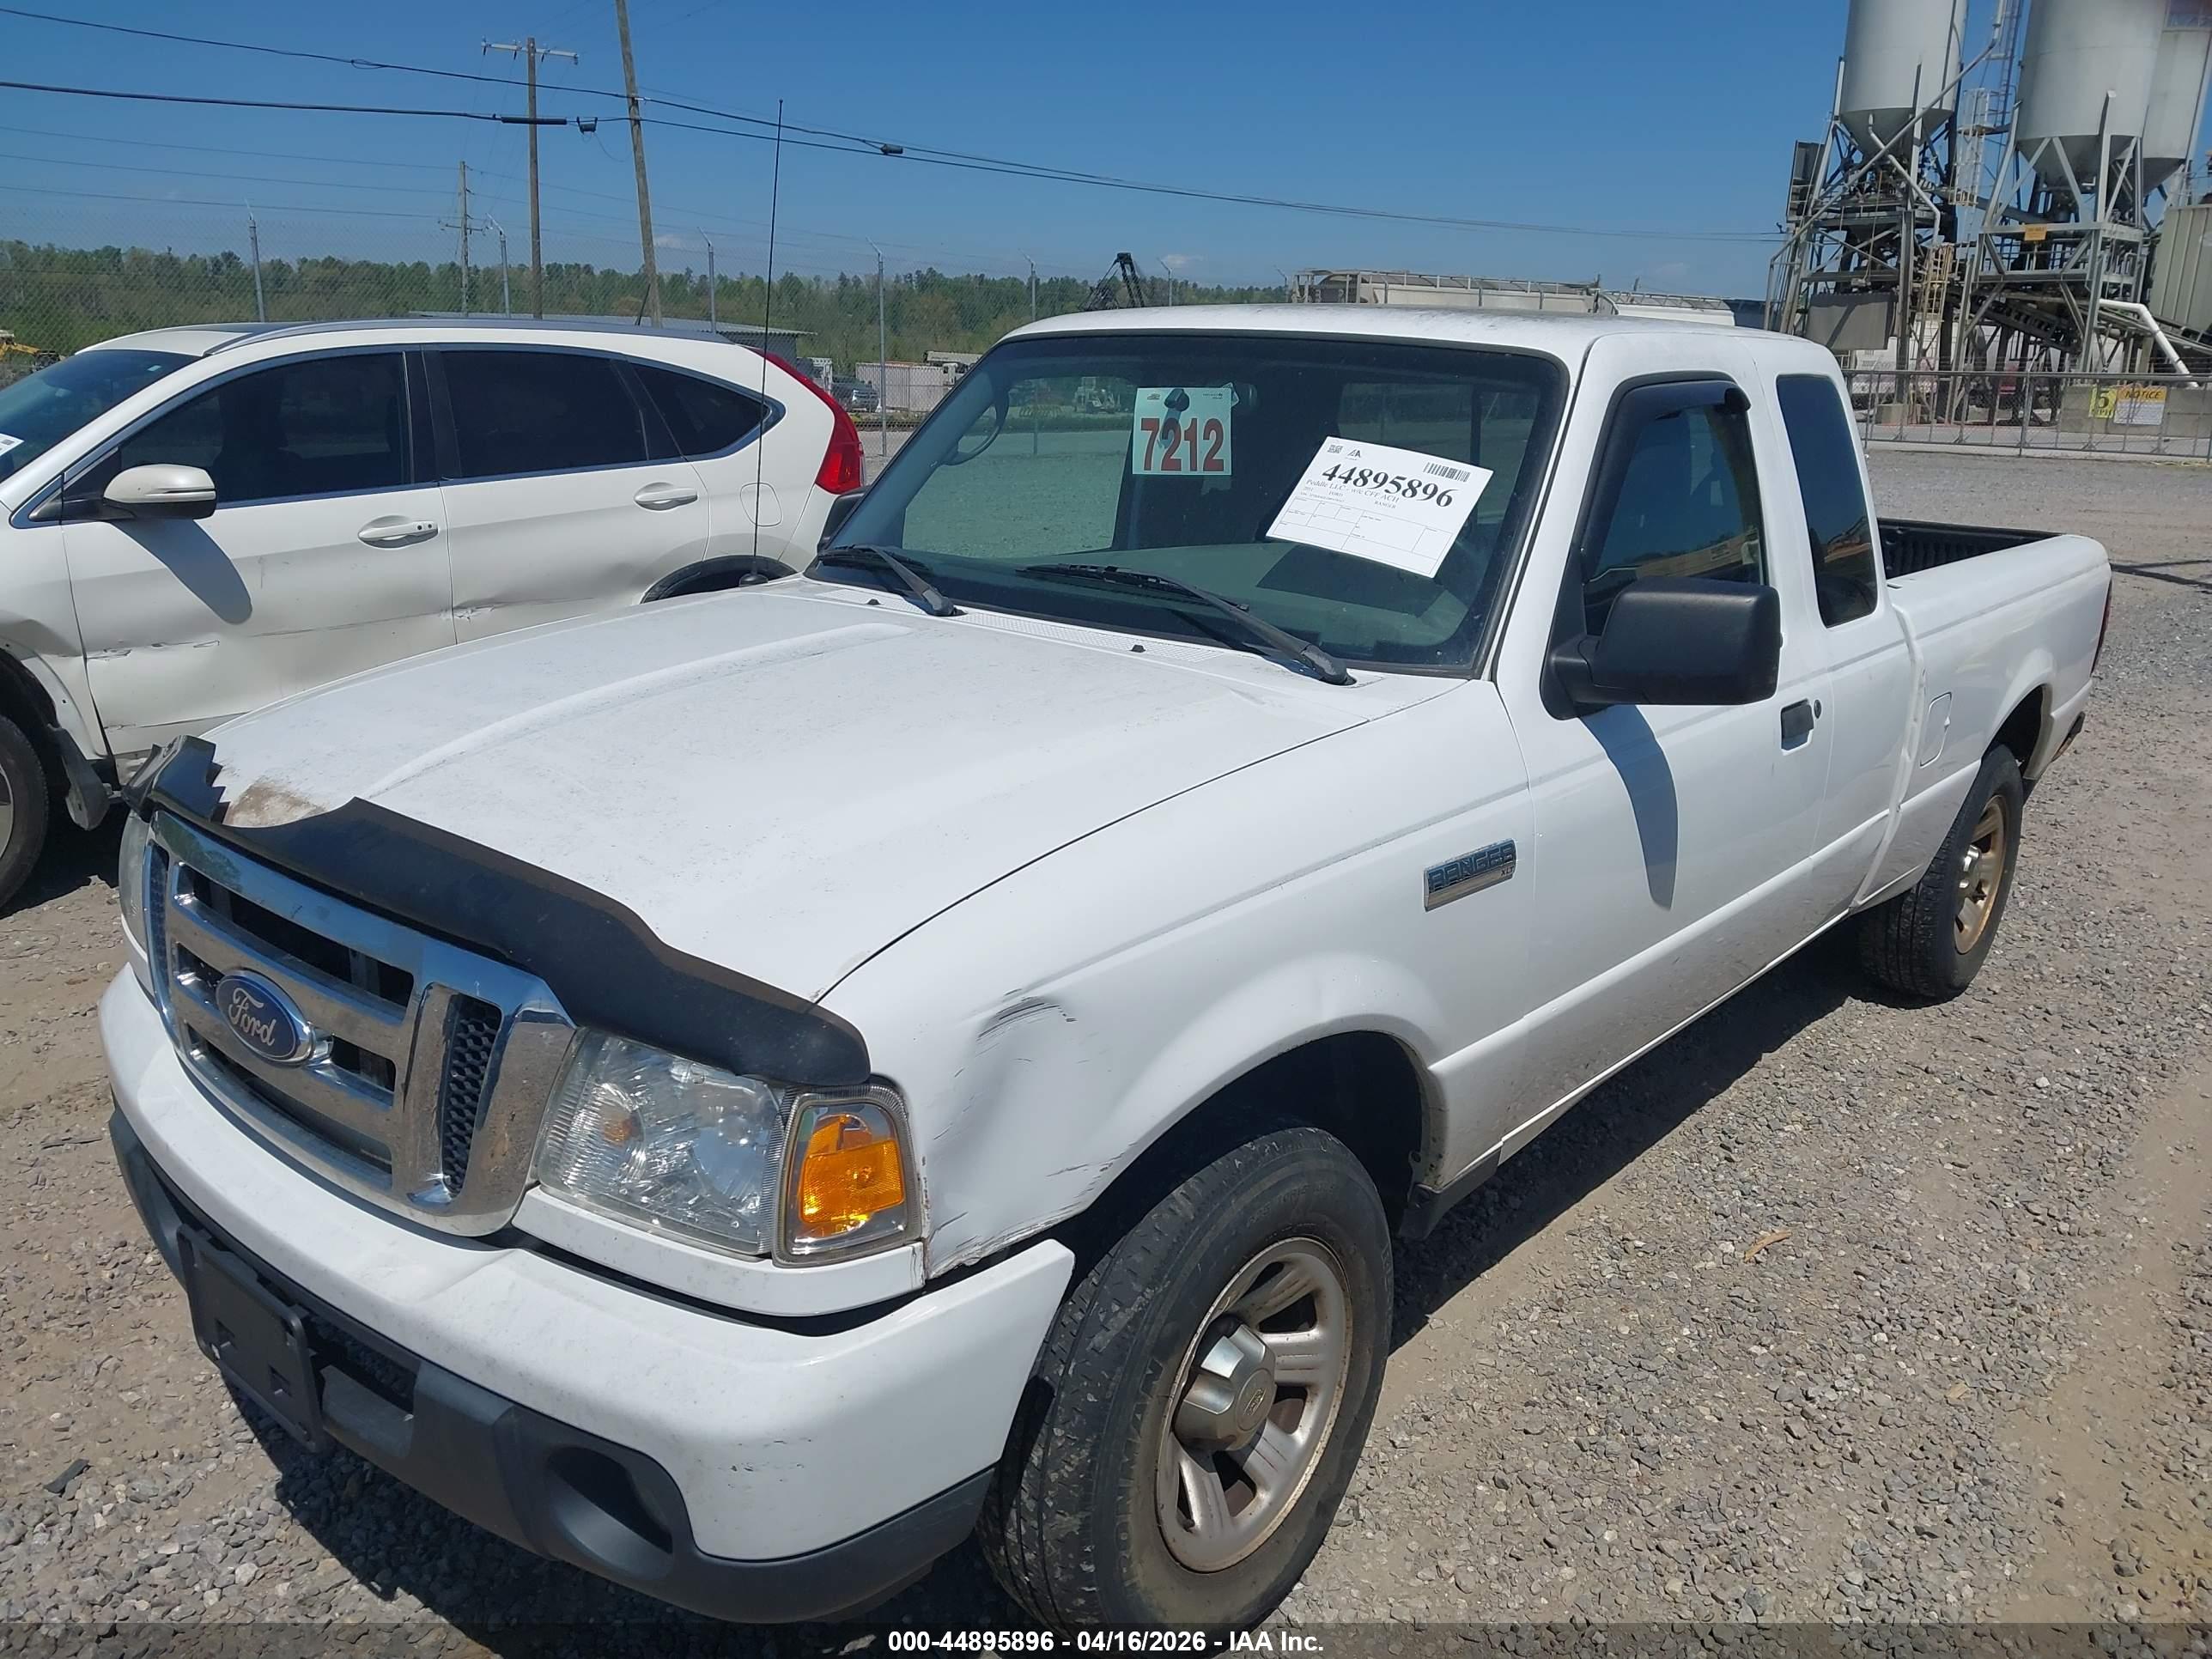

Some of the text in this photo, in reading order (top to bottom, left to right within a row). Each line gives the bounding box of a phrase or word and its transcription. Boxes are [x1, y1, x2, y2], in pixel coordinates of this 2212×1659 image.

[2098, 390, 2110, 409] 5
[2124, 390, 2162, 400] NOTICE
[1140, 417, 1224, 472] 7212
[1322, 462, 1460, 508] 44895896
[1328, 482, 1346, 490] LLC
[1428, 842, 1515, 894] RANGER
[1500, 866, 1515, 878] XLT
[228, 988, 276, 1046] Ford
